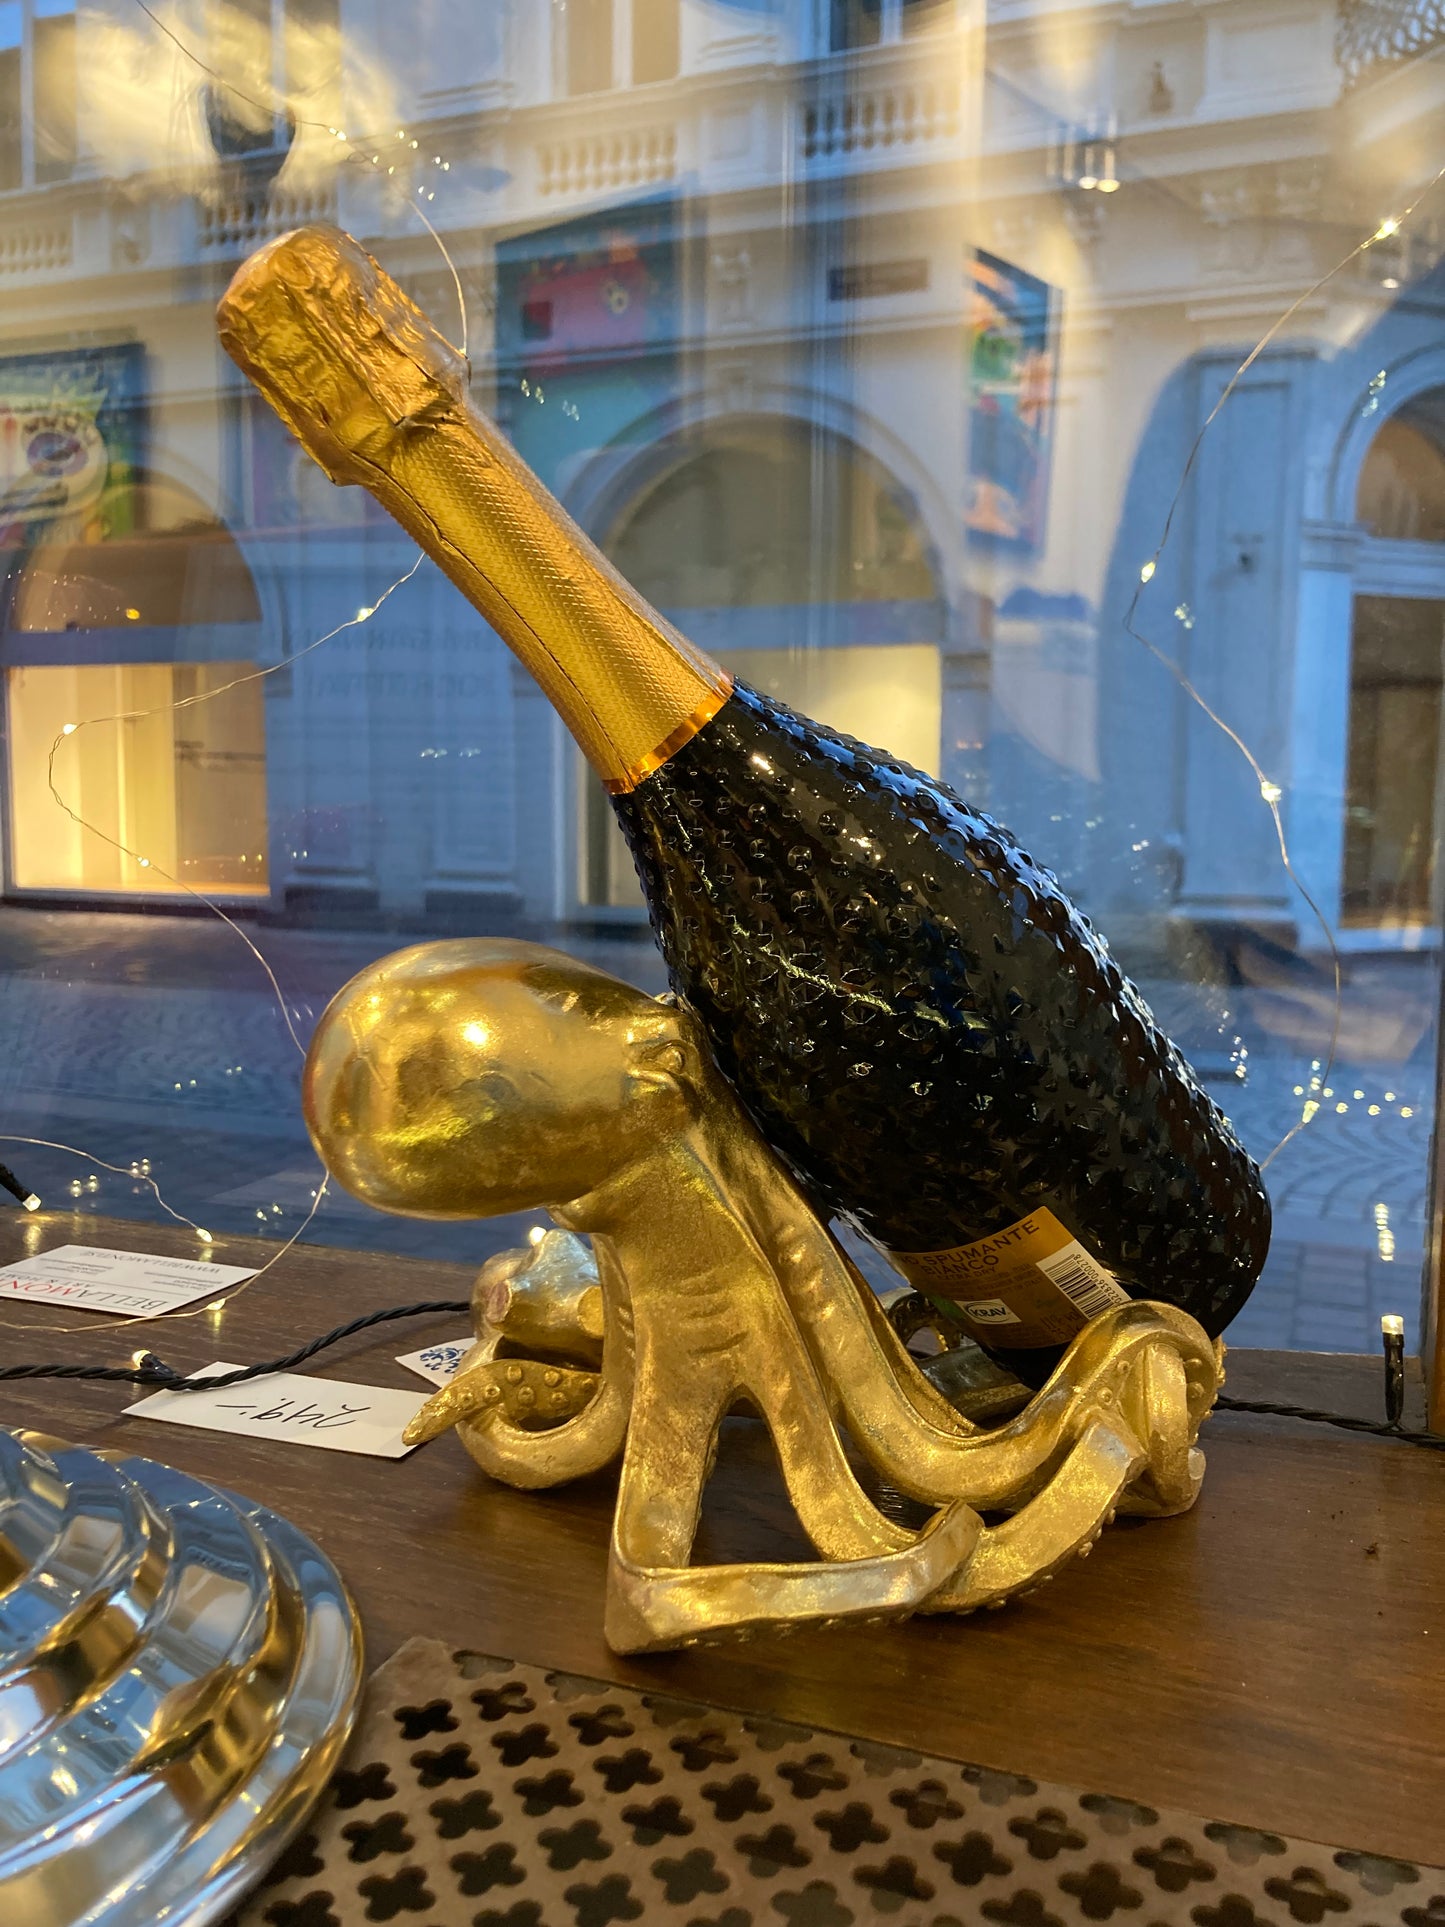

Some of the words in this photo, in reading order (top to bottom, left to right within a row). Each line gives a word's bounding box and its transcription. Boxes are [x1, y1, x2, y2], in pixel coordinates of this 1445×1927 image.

[923, 1219, 1040, 1265] SPUMANTE
[920, 1254, 999, 1275] BIANCO
[973, 1265, 997, 1278] DRY
[969, 1306, 1007, 1317] KRAV
[215, 1397, 371, 1429] 249:-
